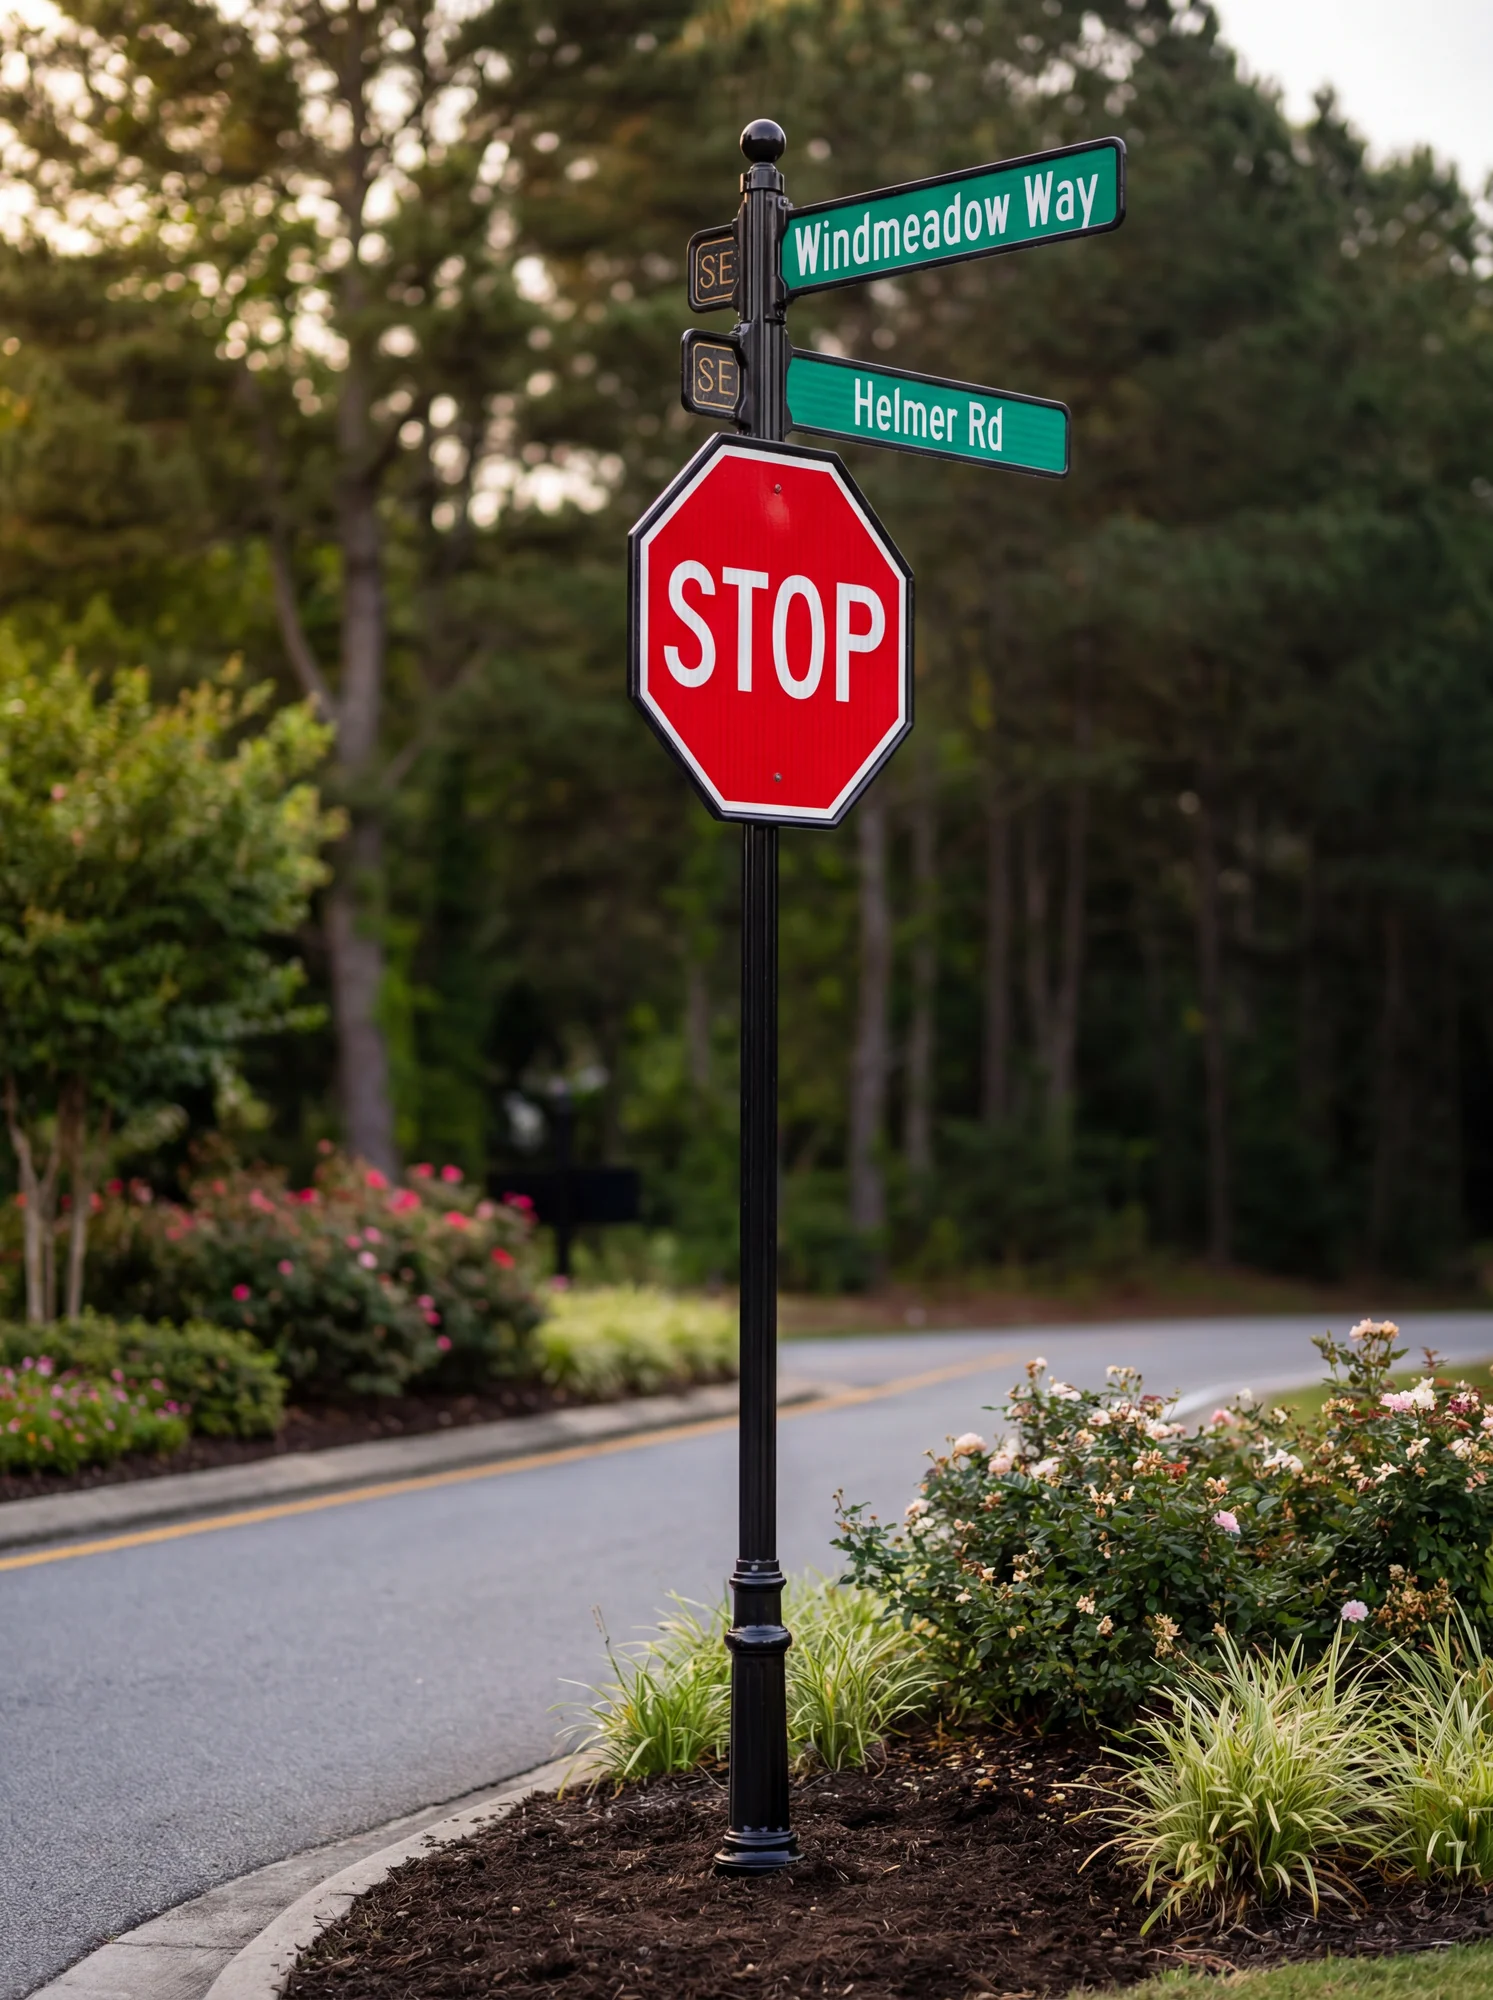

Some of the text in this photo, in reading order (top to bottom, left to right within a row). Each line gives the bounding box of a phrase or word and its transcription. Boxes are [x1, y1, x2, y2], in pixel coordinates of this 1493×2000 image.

[794, 170, 1099, 277] Windmeadow Way
[699, 250, 735, 289] SE
[697, 356, 735, 396] SE
[853, 377, 1004, 452] Helmer Rd
[663, 559, 887, 703] STOP
